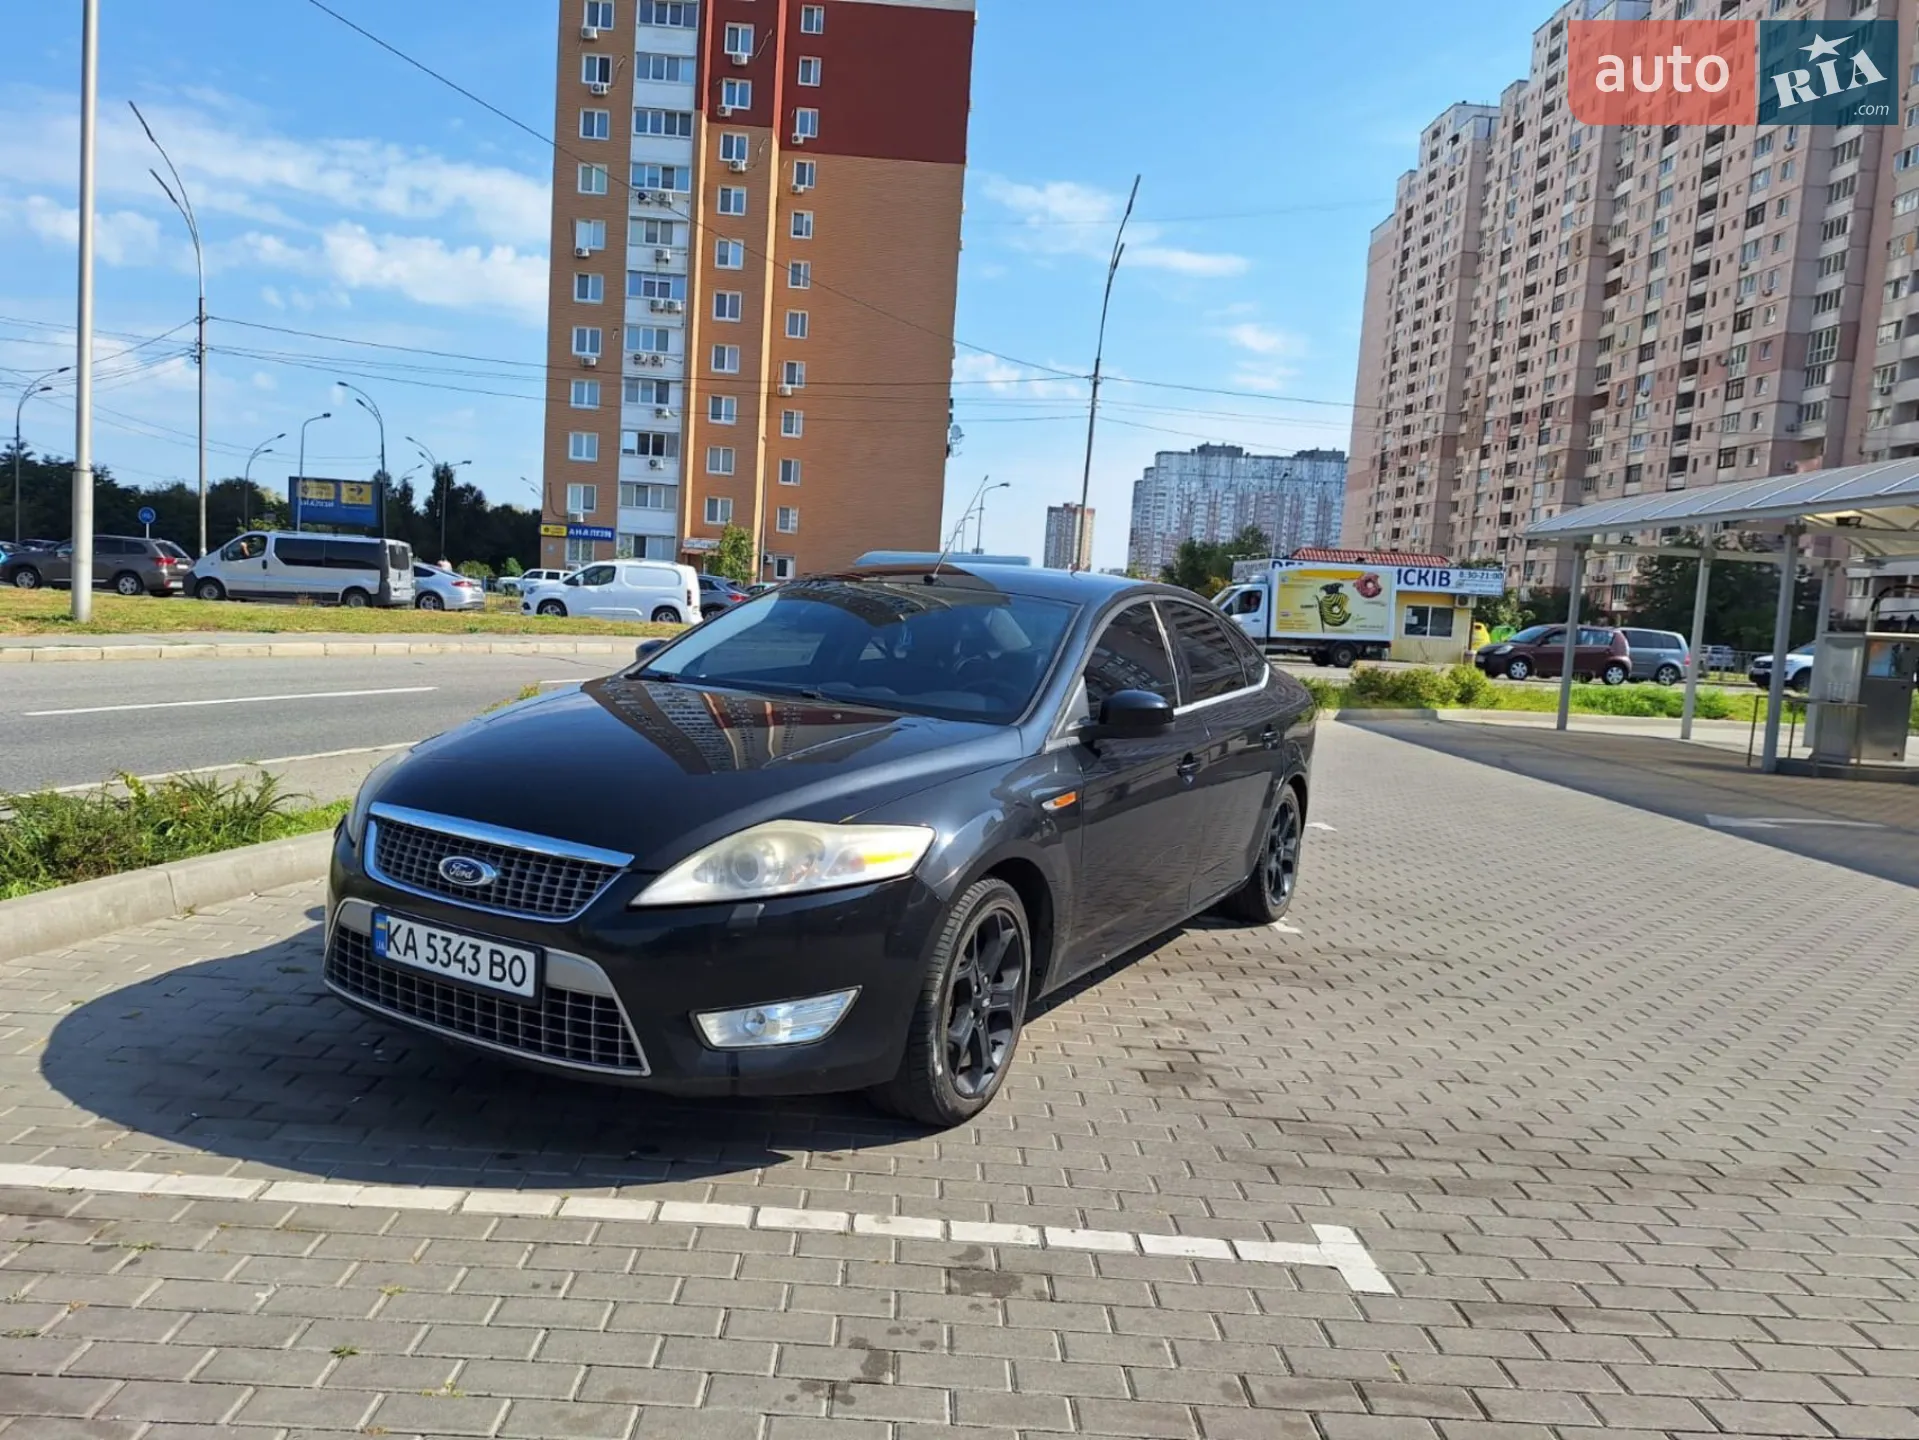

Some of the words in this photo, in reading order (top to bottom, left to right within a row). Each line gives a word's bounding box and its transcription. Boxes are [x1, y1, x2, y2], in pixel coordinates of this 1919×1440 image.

[449, 862, 474, 879] Ford
[387, 921, 418, 960] KA
[425, 932, 481, 976] 5343
[488, 948, 526, 987] BO
